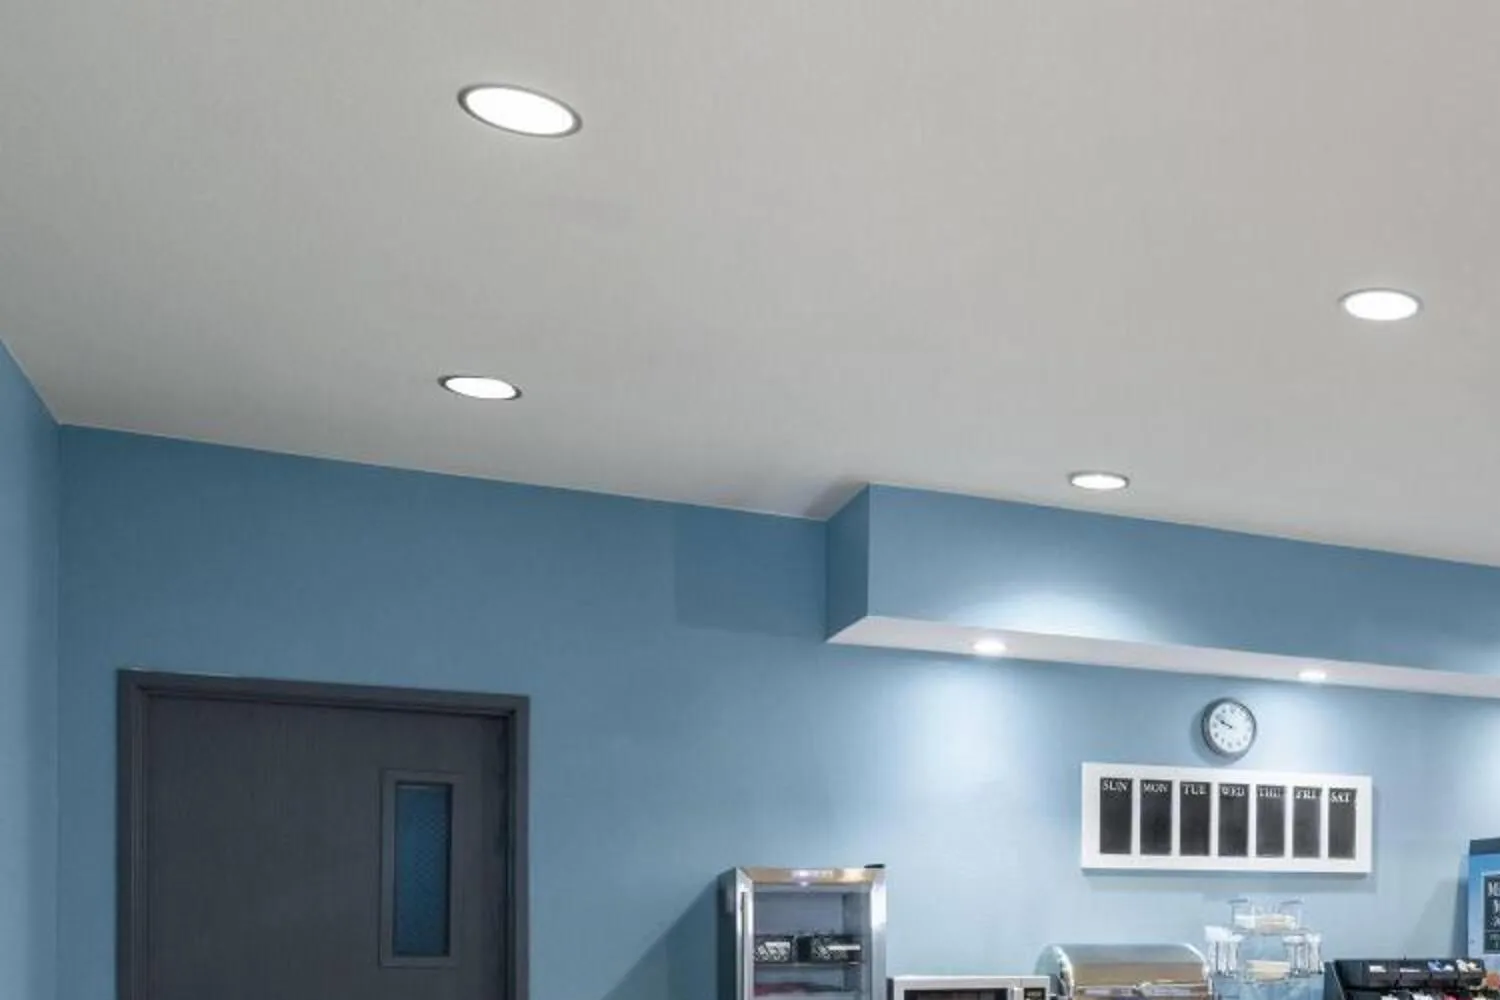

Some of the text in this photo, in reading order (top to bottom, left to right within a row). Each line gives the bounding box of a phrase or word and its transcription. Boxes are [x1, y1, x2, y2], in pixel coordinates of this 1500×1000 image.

[1103, 780, 1129, 793] SUN
[1143, 783, 1169, 793] MON
[1183, 784, 1208, 796] TUE
[1331, 791, 1351, 803] SAT
